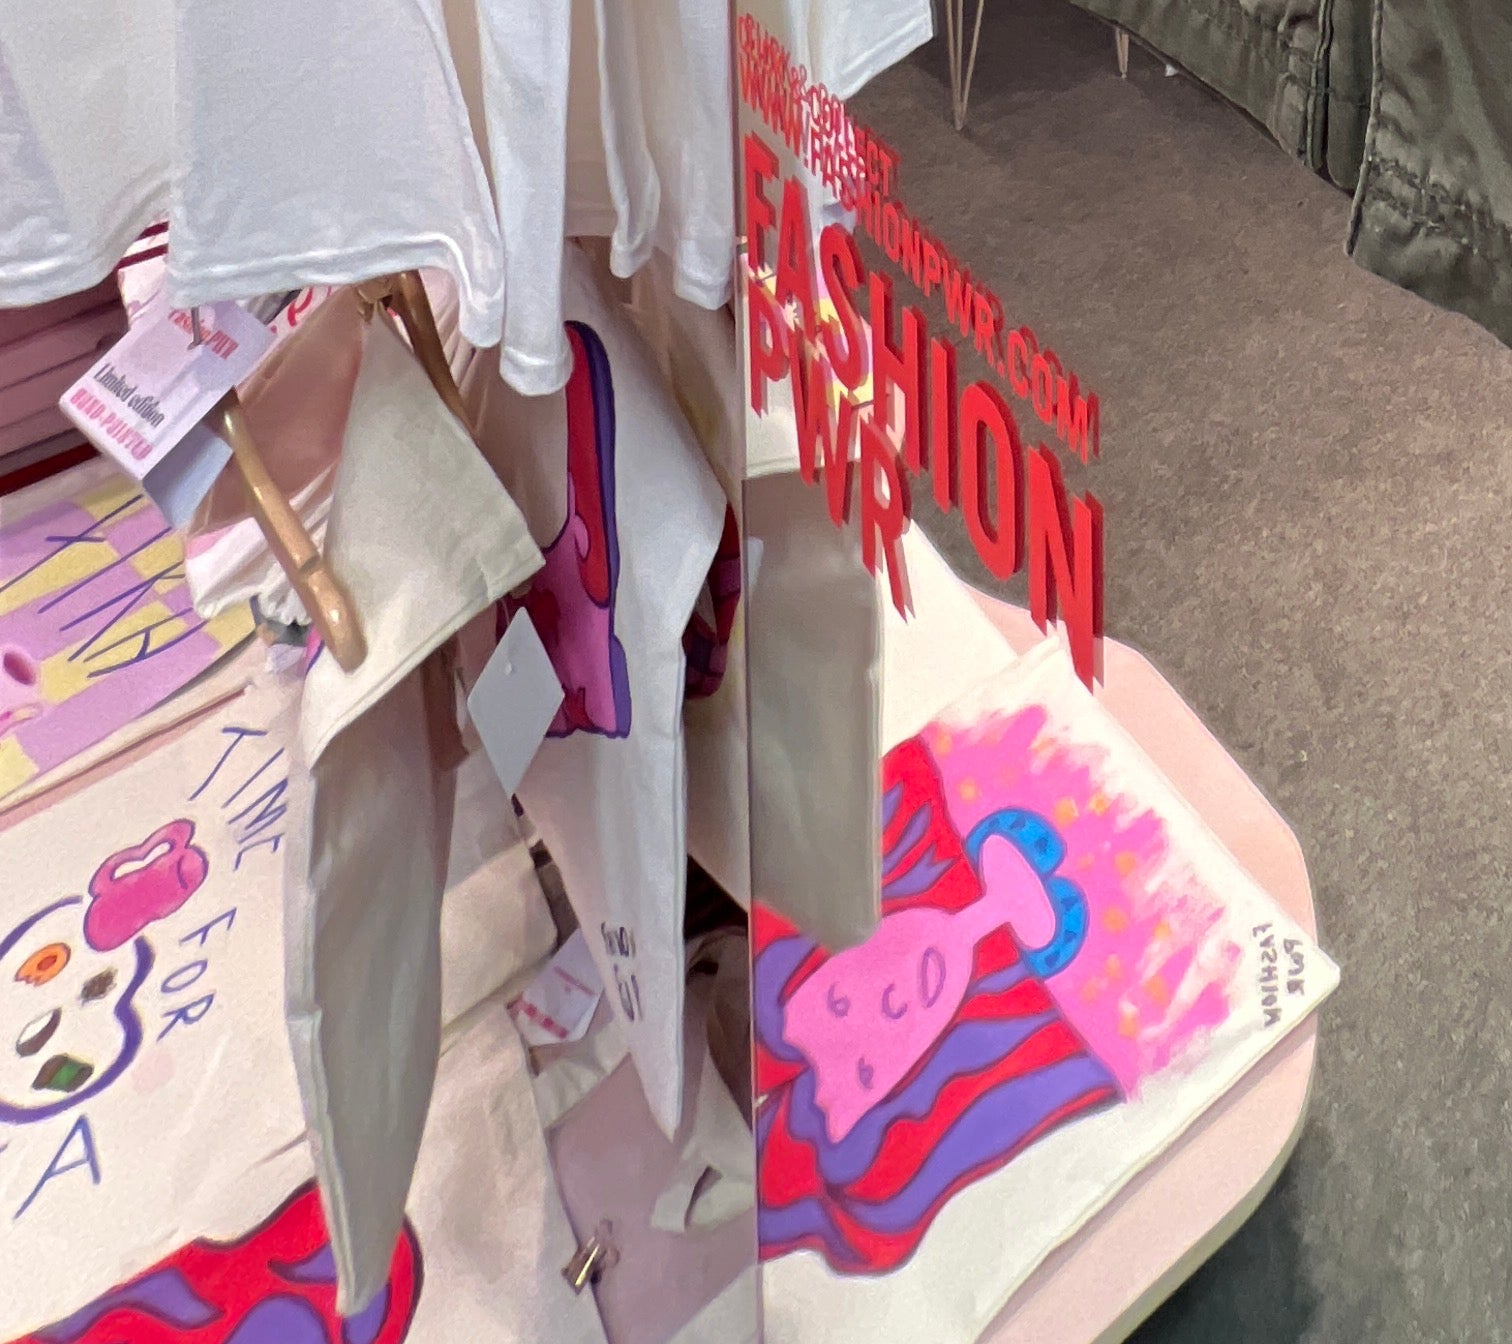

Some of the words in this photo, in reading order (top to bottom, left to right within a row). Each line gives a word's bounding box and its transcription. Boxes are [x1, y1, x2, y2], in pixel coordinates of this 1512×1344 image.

[745, 133, 1096, 695] FASHION
[747, 275, 911, 621] PWR
[157, 908, 237, 1041] FOR
